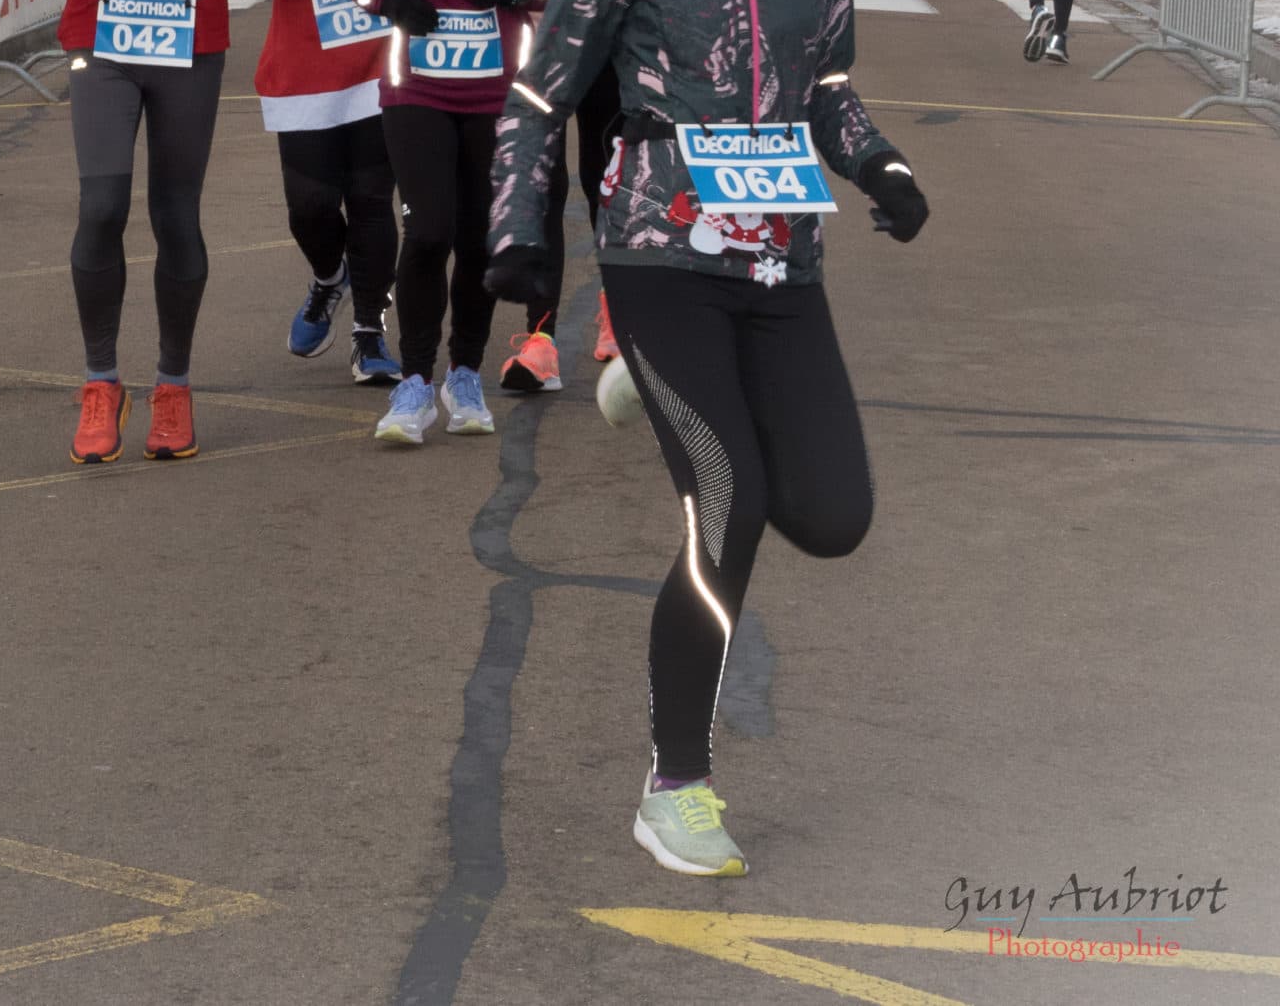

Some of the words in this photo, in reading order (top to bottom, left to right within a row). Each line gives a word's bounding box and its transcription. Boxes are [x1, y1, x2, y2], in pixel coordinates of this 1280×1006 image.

[437, 15, 493, 31] CATHLON
[112, 24, 177, 56] 042
[425, 40, 488, 68] 077
[692, 133, 802, 155] DECATHLON
[714, 167, 808, 200] 064
